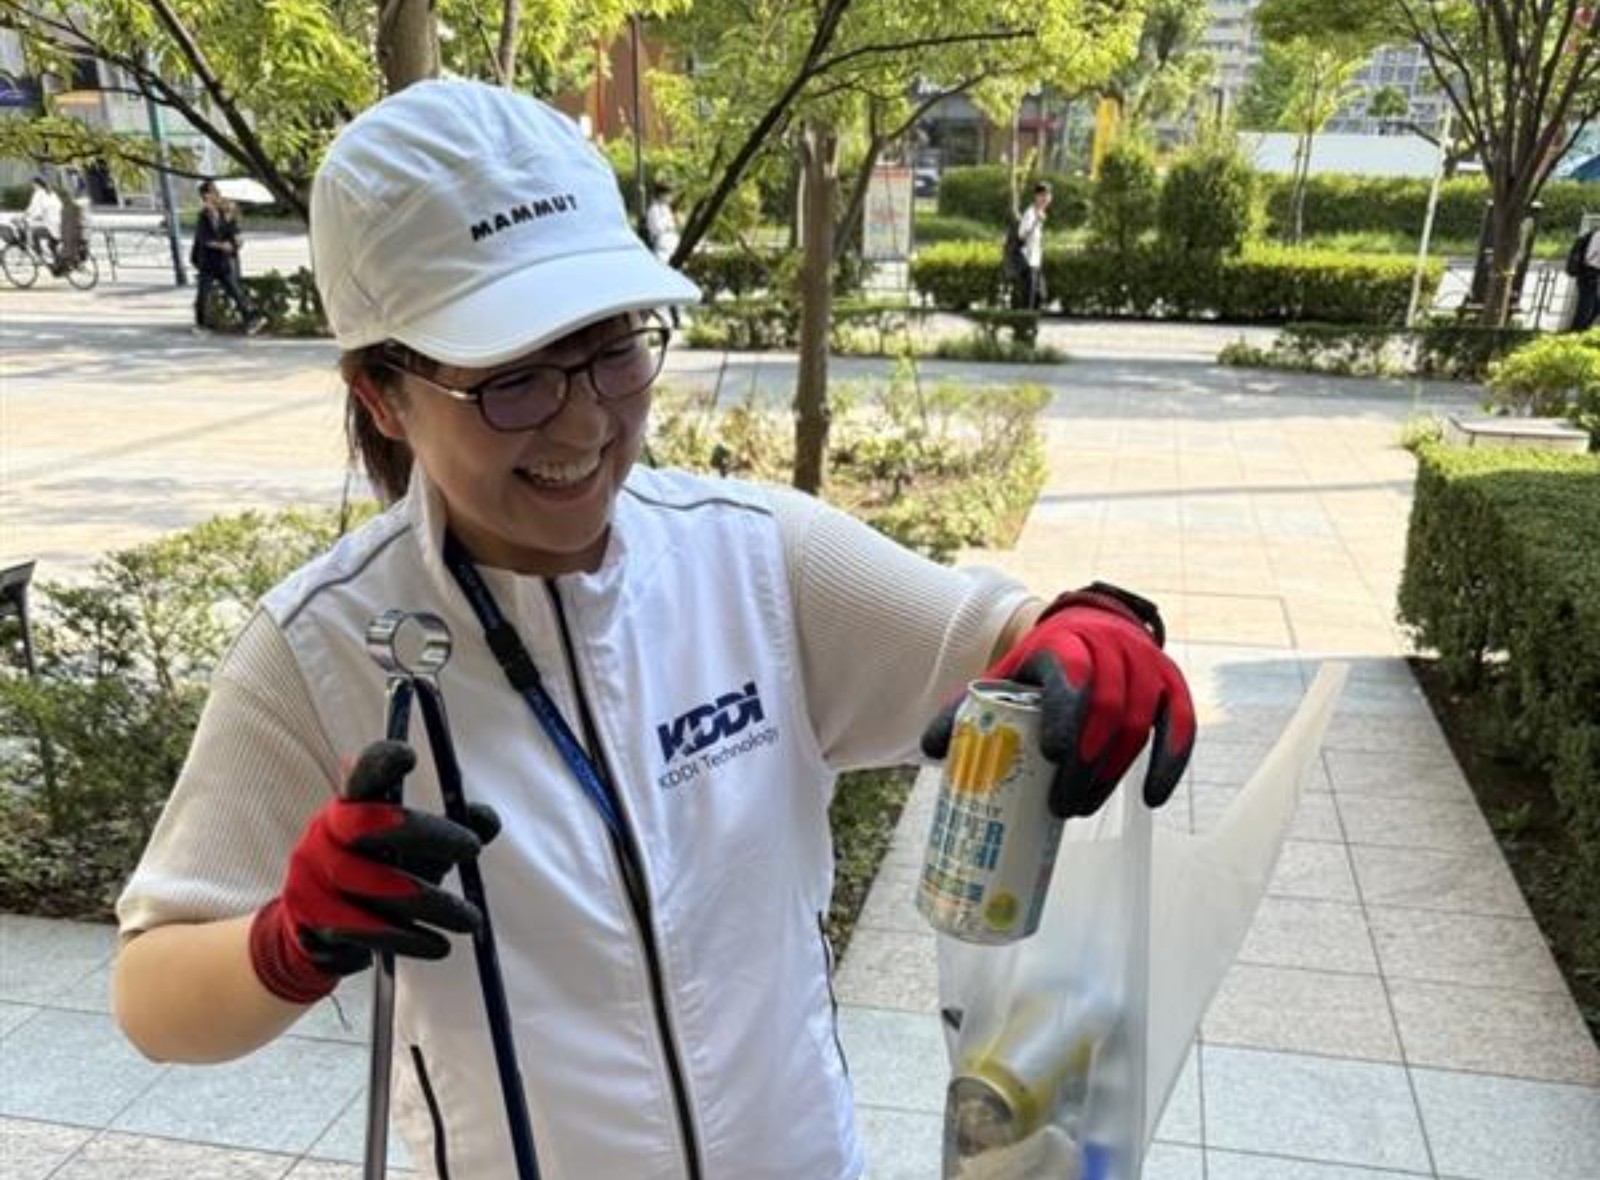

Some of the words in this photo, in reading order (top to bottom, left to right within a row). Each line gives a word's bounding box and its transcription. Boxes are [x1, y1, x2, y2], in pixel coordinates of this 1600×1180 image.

[470, 193, 577, 241] MAMMUT
[657, 680, 764, 764] KDDI
[658, 762, 699, 789] KDDI
[699, 727, 778, 769] Technology
